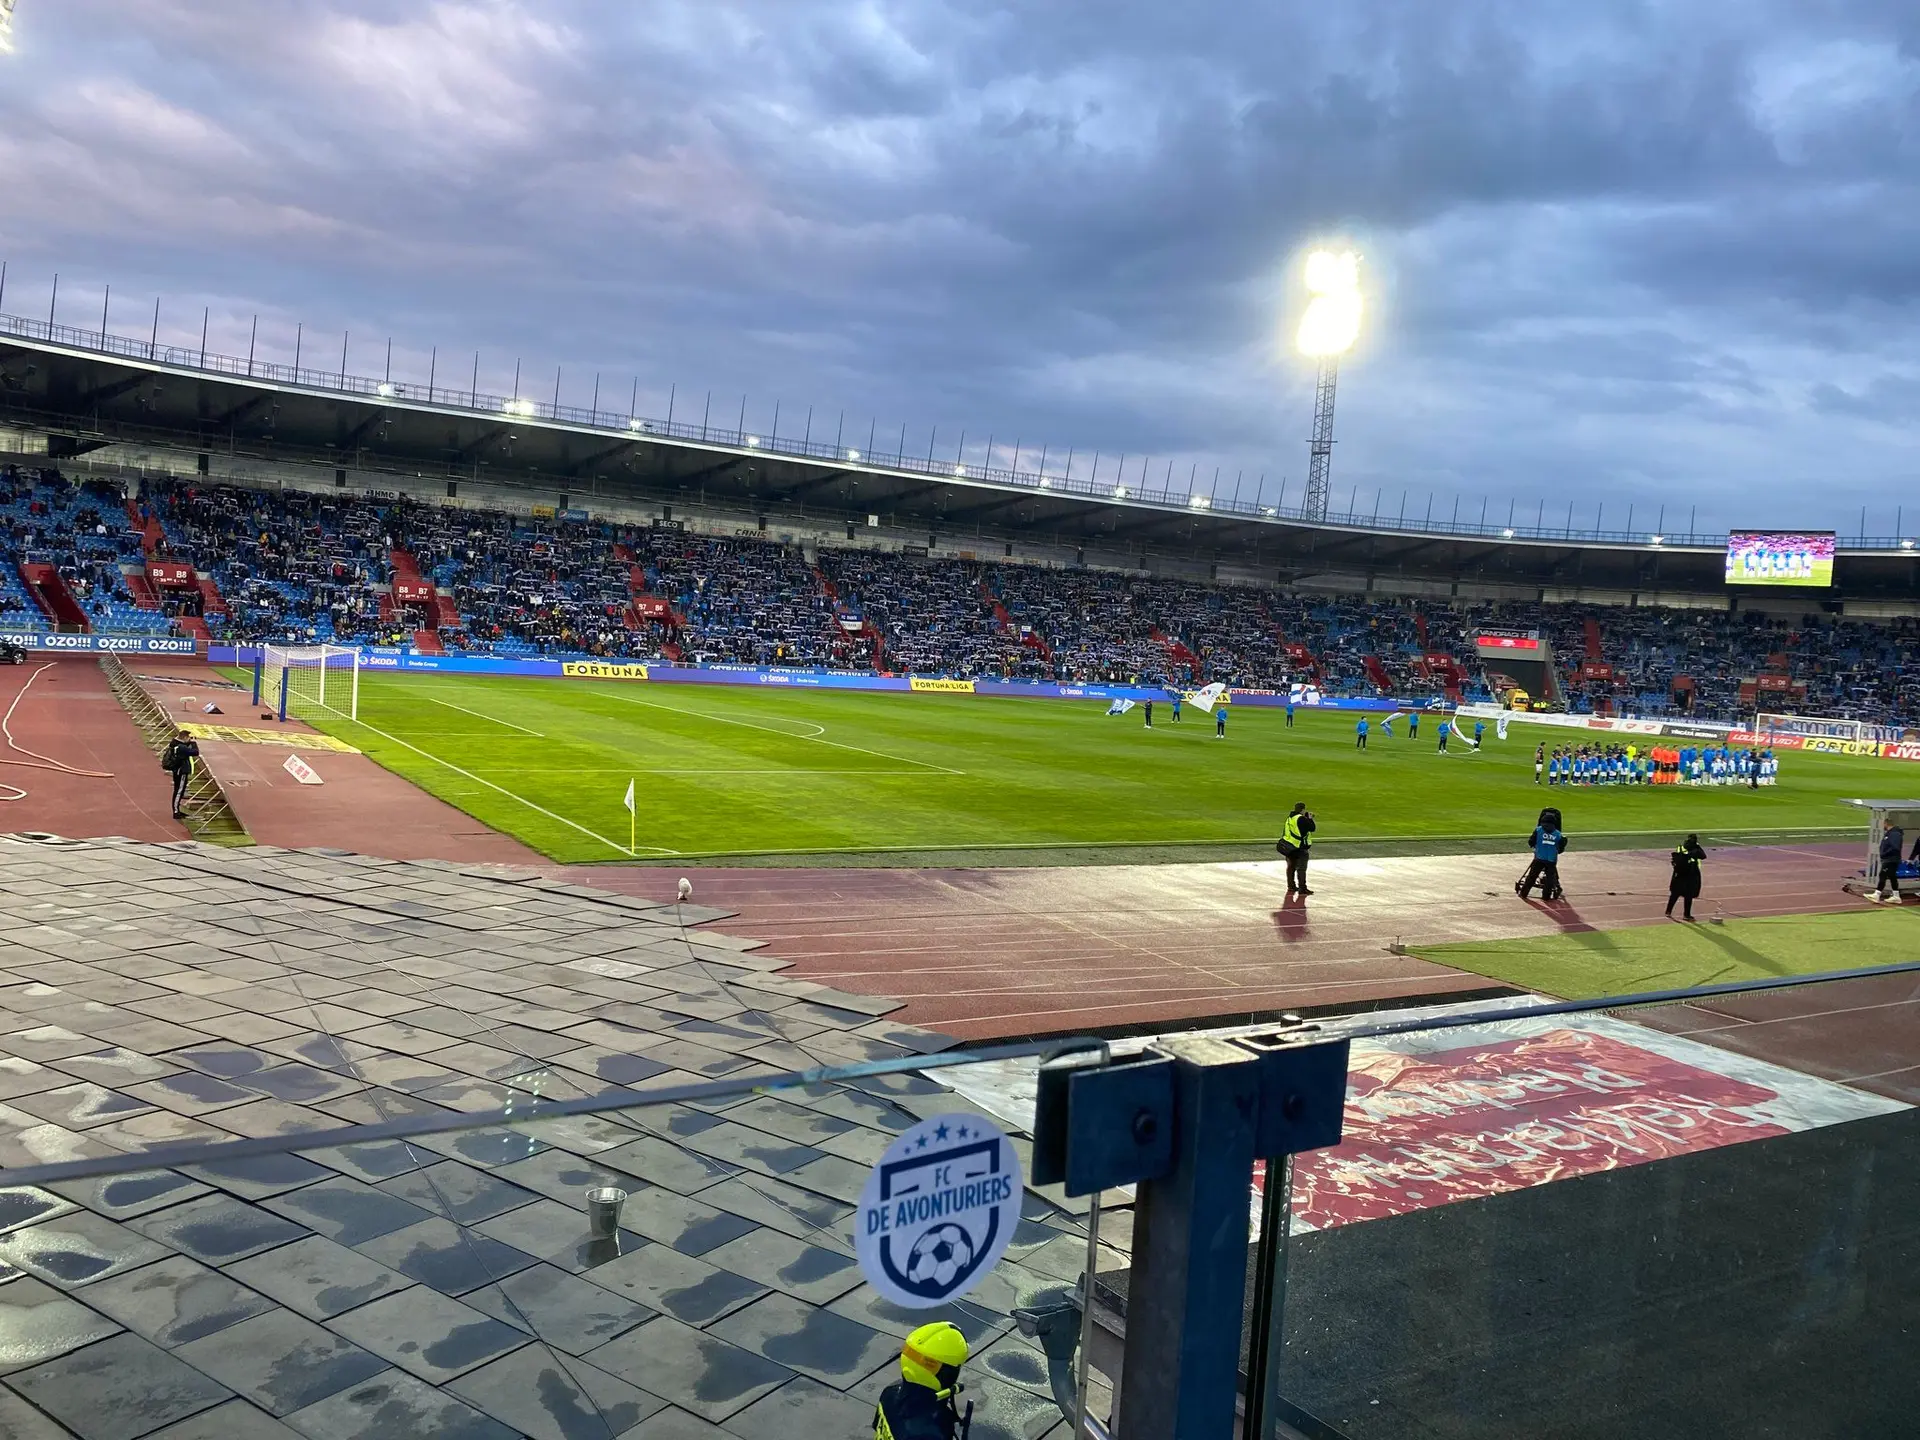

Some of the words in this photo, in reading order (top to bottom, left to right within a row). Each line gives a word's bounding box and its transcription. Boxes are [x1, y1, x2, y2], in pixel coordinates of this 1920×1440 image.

[658, 520, 678, 529] SECO
[45, 636, 91, 648] OZO!!!
[98, 638, 142, 650] OZO!!!
[148, 640, 192, 651] OZO!!!
[369, 656, 398, 666] ŠKODA
[567, 665, 643, 677] FORTUNA
[915, 681, 949, 690] FORTUNA
[951, 682, 969, 690] LIGA
[935, 1166, 952, 1188] FC
[867, 1204, 891, 1235] DE
[895, 1174, 1012, 1229] AVONTURIERS
